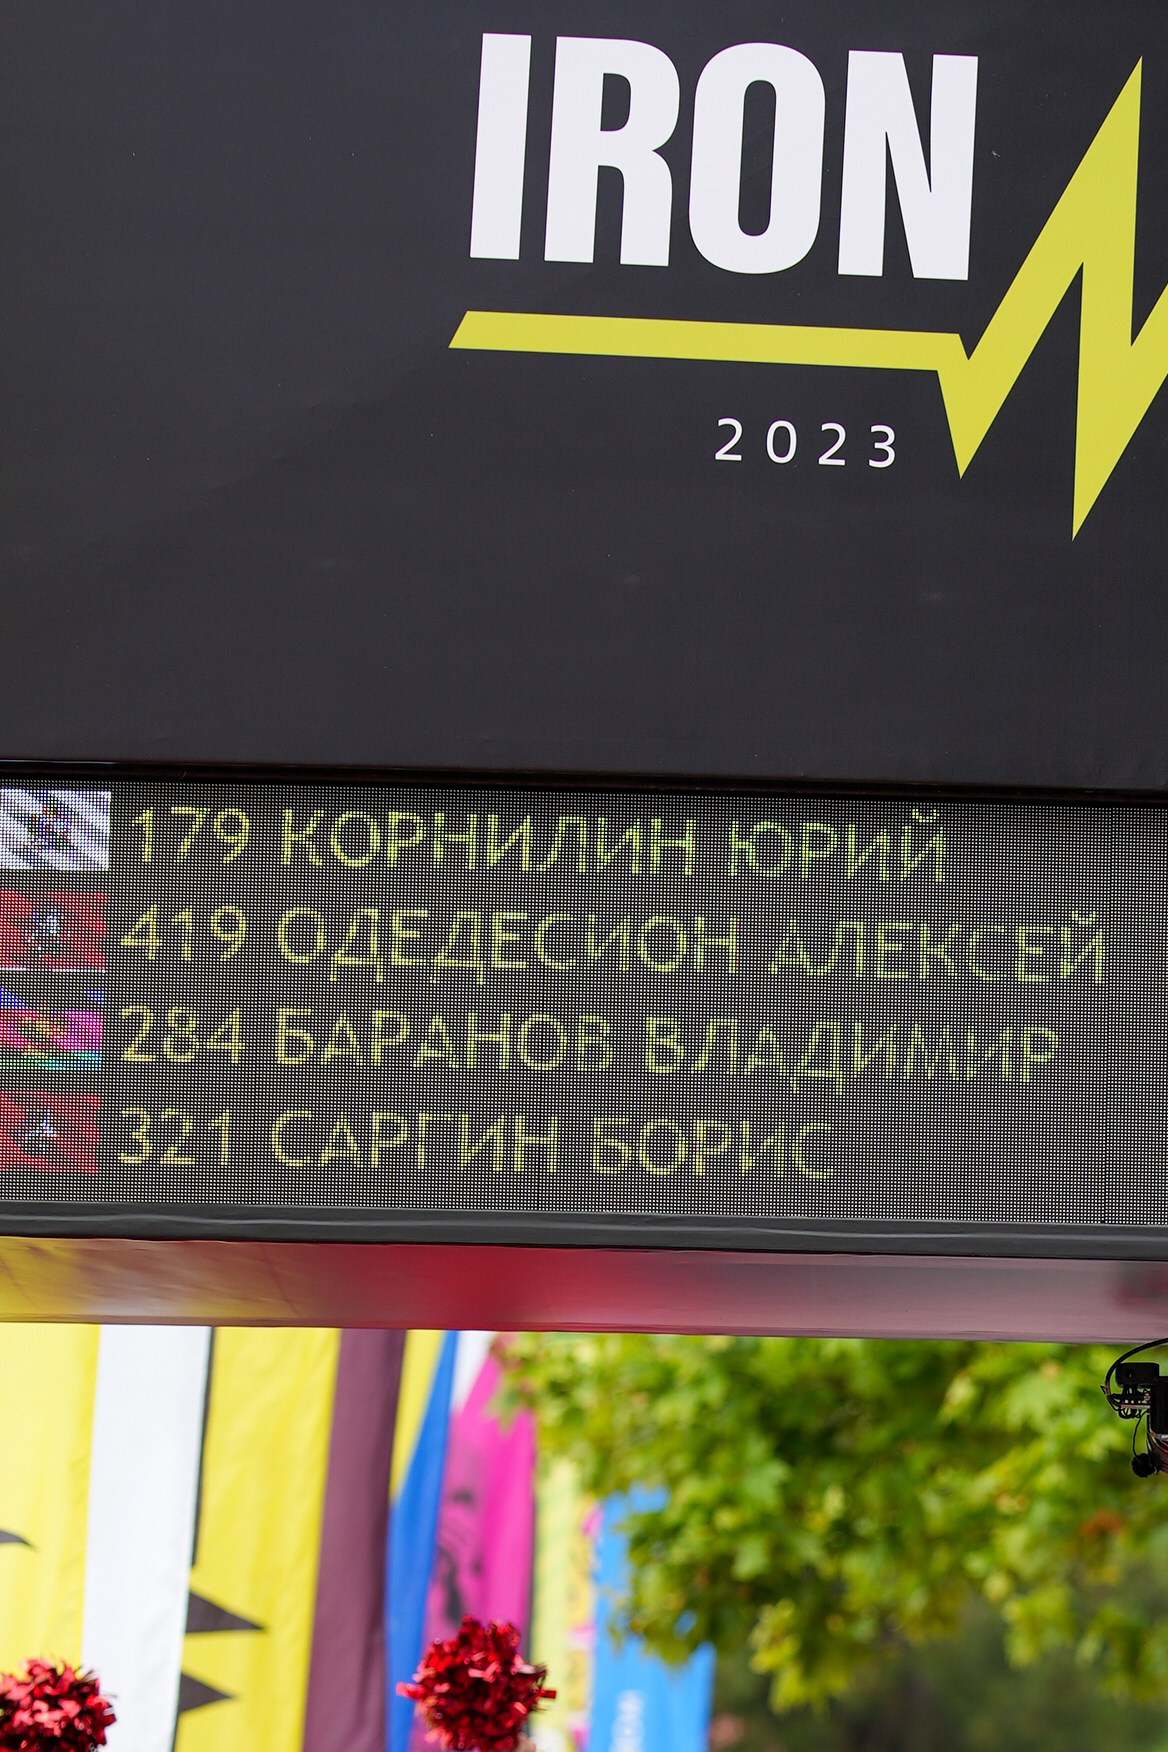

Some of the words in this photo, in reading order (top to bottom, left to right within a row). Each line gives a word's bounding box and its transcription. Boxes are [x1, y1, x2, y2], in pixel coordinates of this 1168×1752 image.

[470, 33, 979, 280] IRON
[714, 418, 898, 468] 2023
[134, 804, 252, 864] 179
[279, 806, 697, 876] КОРНИЛИН
[727, 809, 948, 883] ЮРИЙ
[119, 904, 250, 961] 419
[275, 905, 741, 985] ОДЕДЕСИОН
[768, 908, 1108, 985] АЛЕКСЕЙ
[120, 1003, 245, 1064] 284
[274, 1005, 613, 1072] БАРАНОВ
[642, 1013, 1060, 1096] ВЛАДИМИР
[117, 1104, 232, 1166] 321
[269, 1107, 560, 1174] САРГИН
[590, 1116, 834, 1180] БОРИС
